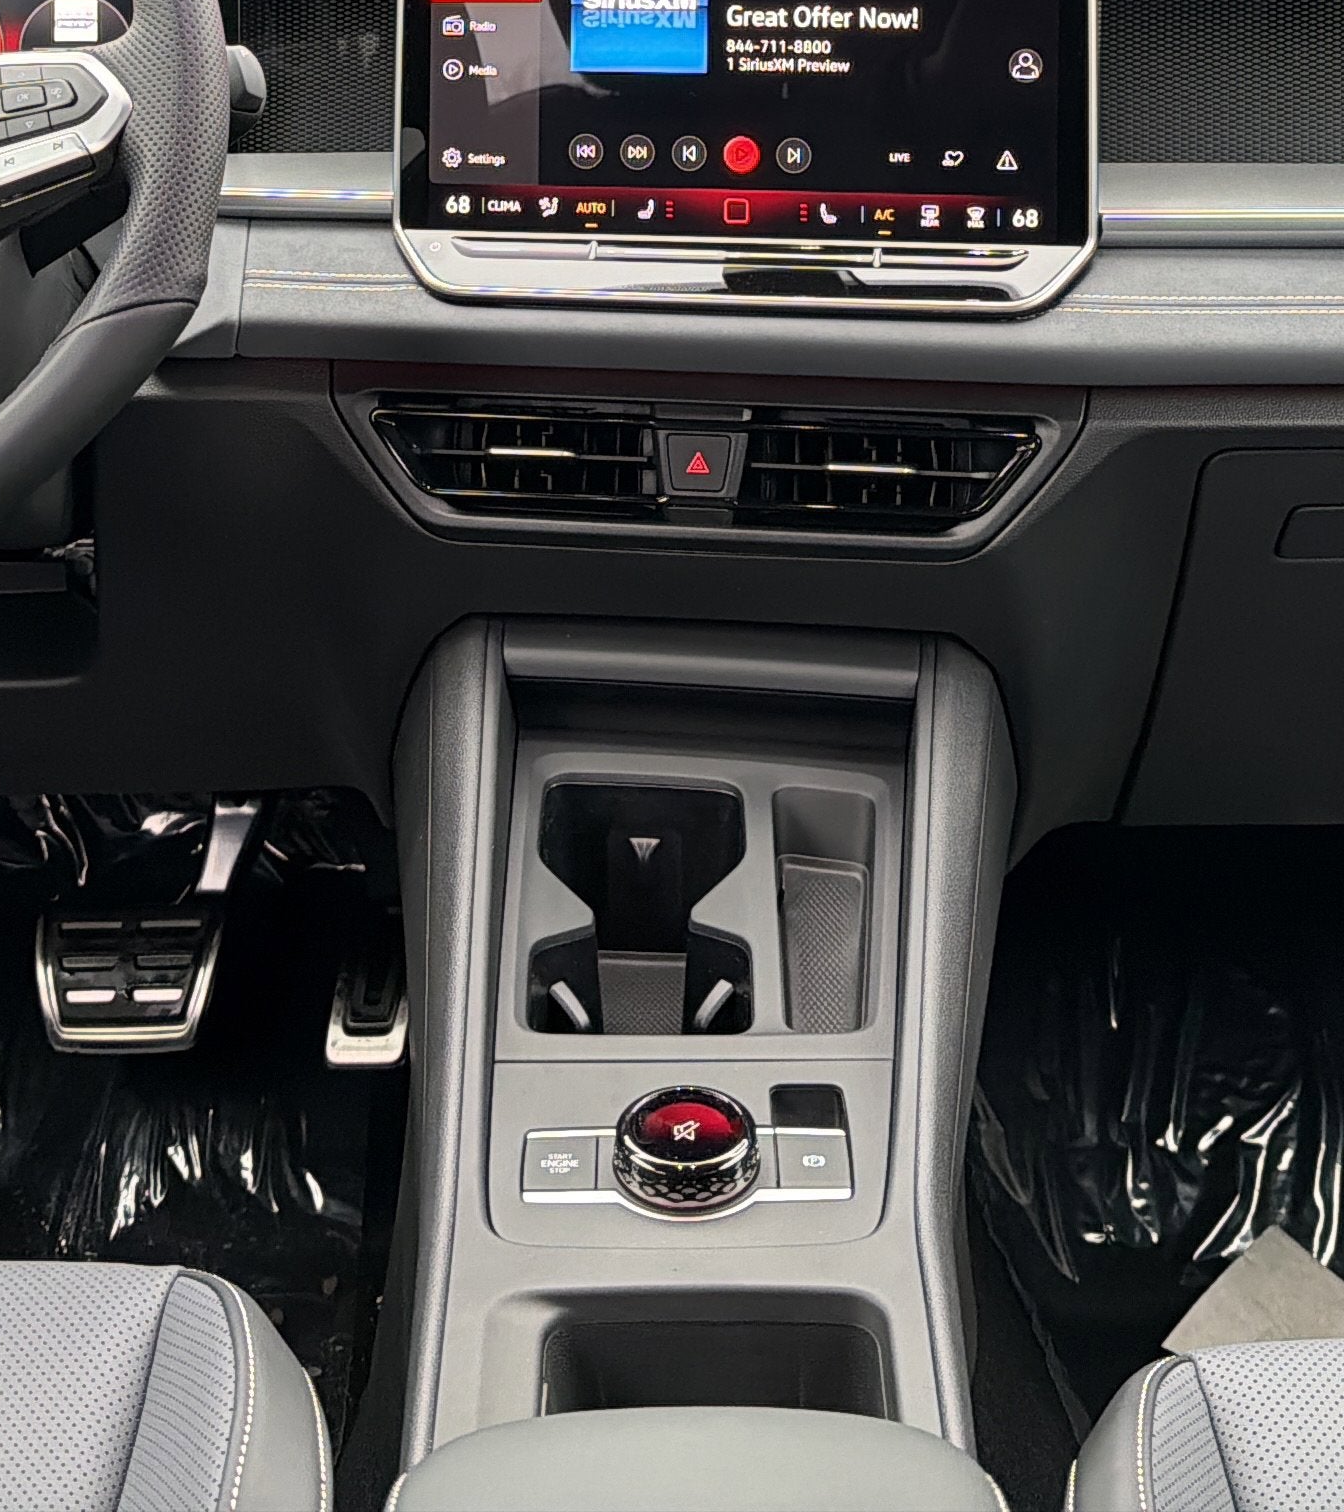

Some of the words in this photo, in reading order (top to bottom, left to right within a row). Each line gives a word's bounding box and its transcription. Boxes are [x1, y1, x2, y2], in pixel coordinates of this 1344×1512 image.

[726, 5, 788, 28] Great
[793, 6, 853, 29] Offer
[859, 7, 919, 30] Now!
[469, 21, 496, 32] Radio
[726, 39, 831, 54] 844-711-8800
[469, 65, 498, 76] Media
[727, 58, 734, 71] 1
[739, 58, 794, 72] SiriusXM
[798, 59, 850, 73] Preview
[16, 94, 30, 102] OK
[467, 153, 505, 166] Settings
[889, 152, 911, 163] LIVE
[445, 195, 471, 214] 68
[488, 200, 521, 212] CLIMA
[576, 202, 606, 214] AUTO
[874, 209, 896, 221] A/C
[1012, 209, 1039, 228] 68
[921, 219, 940, 227] REAR
[967, 221, 984, 229] MAX
